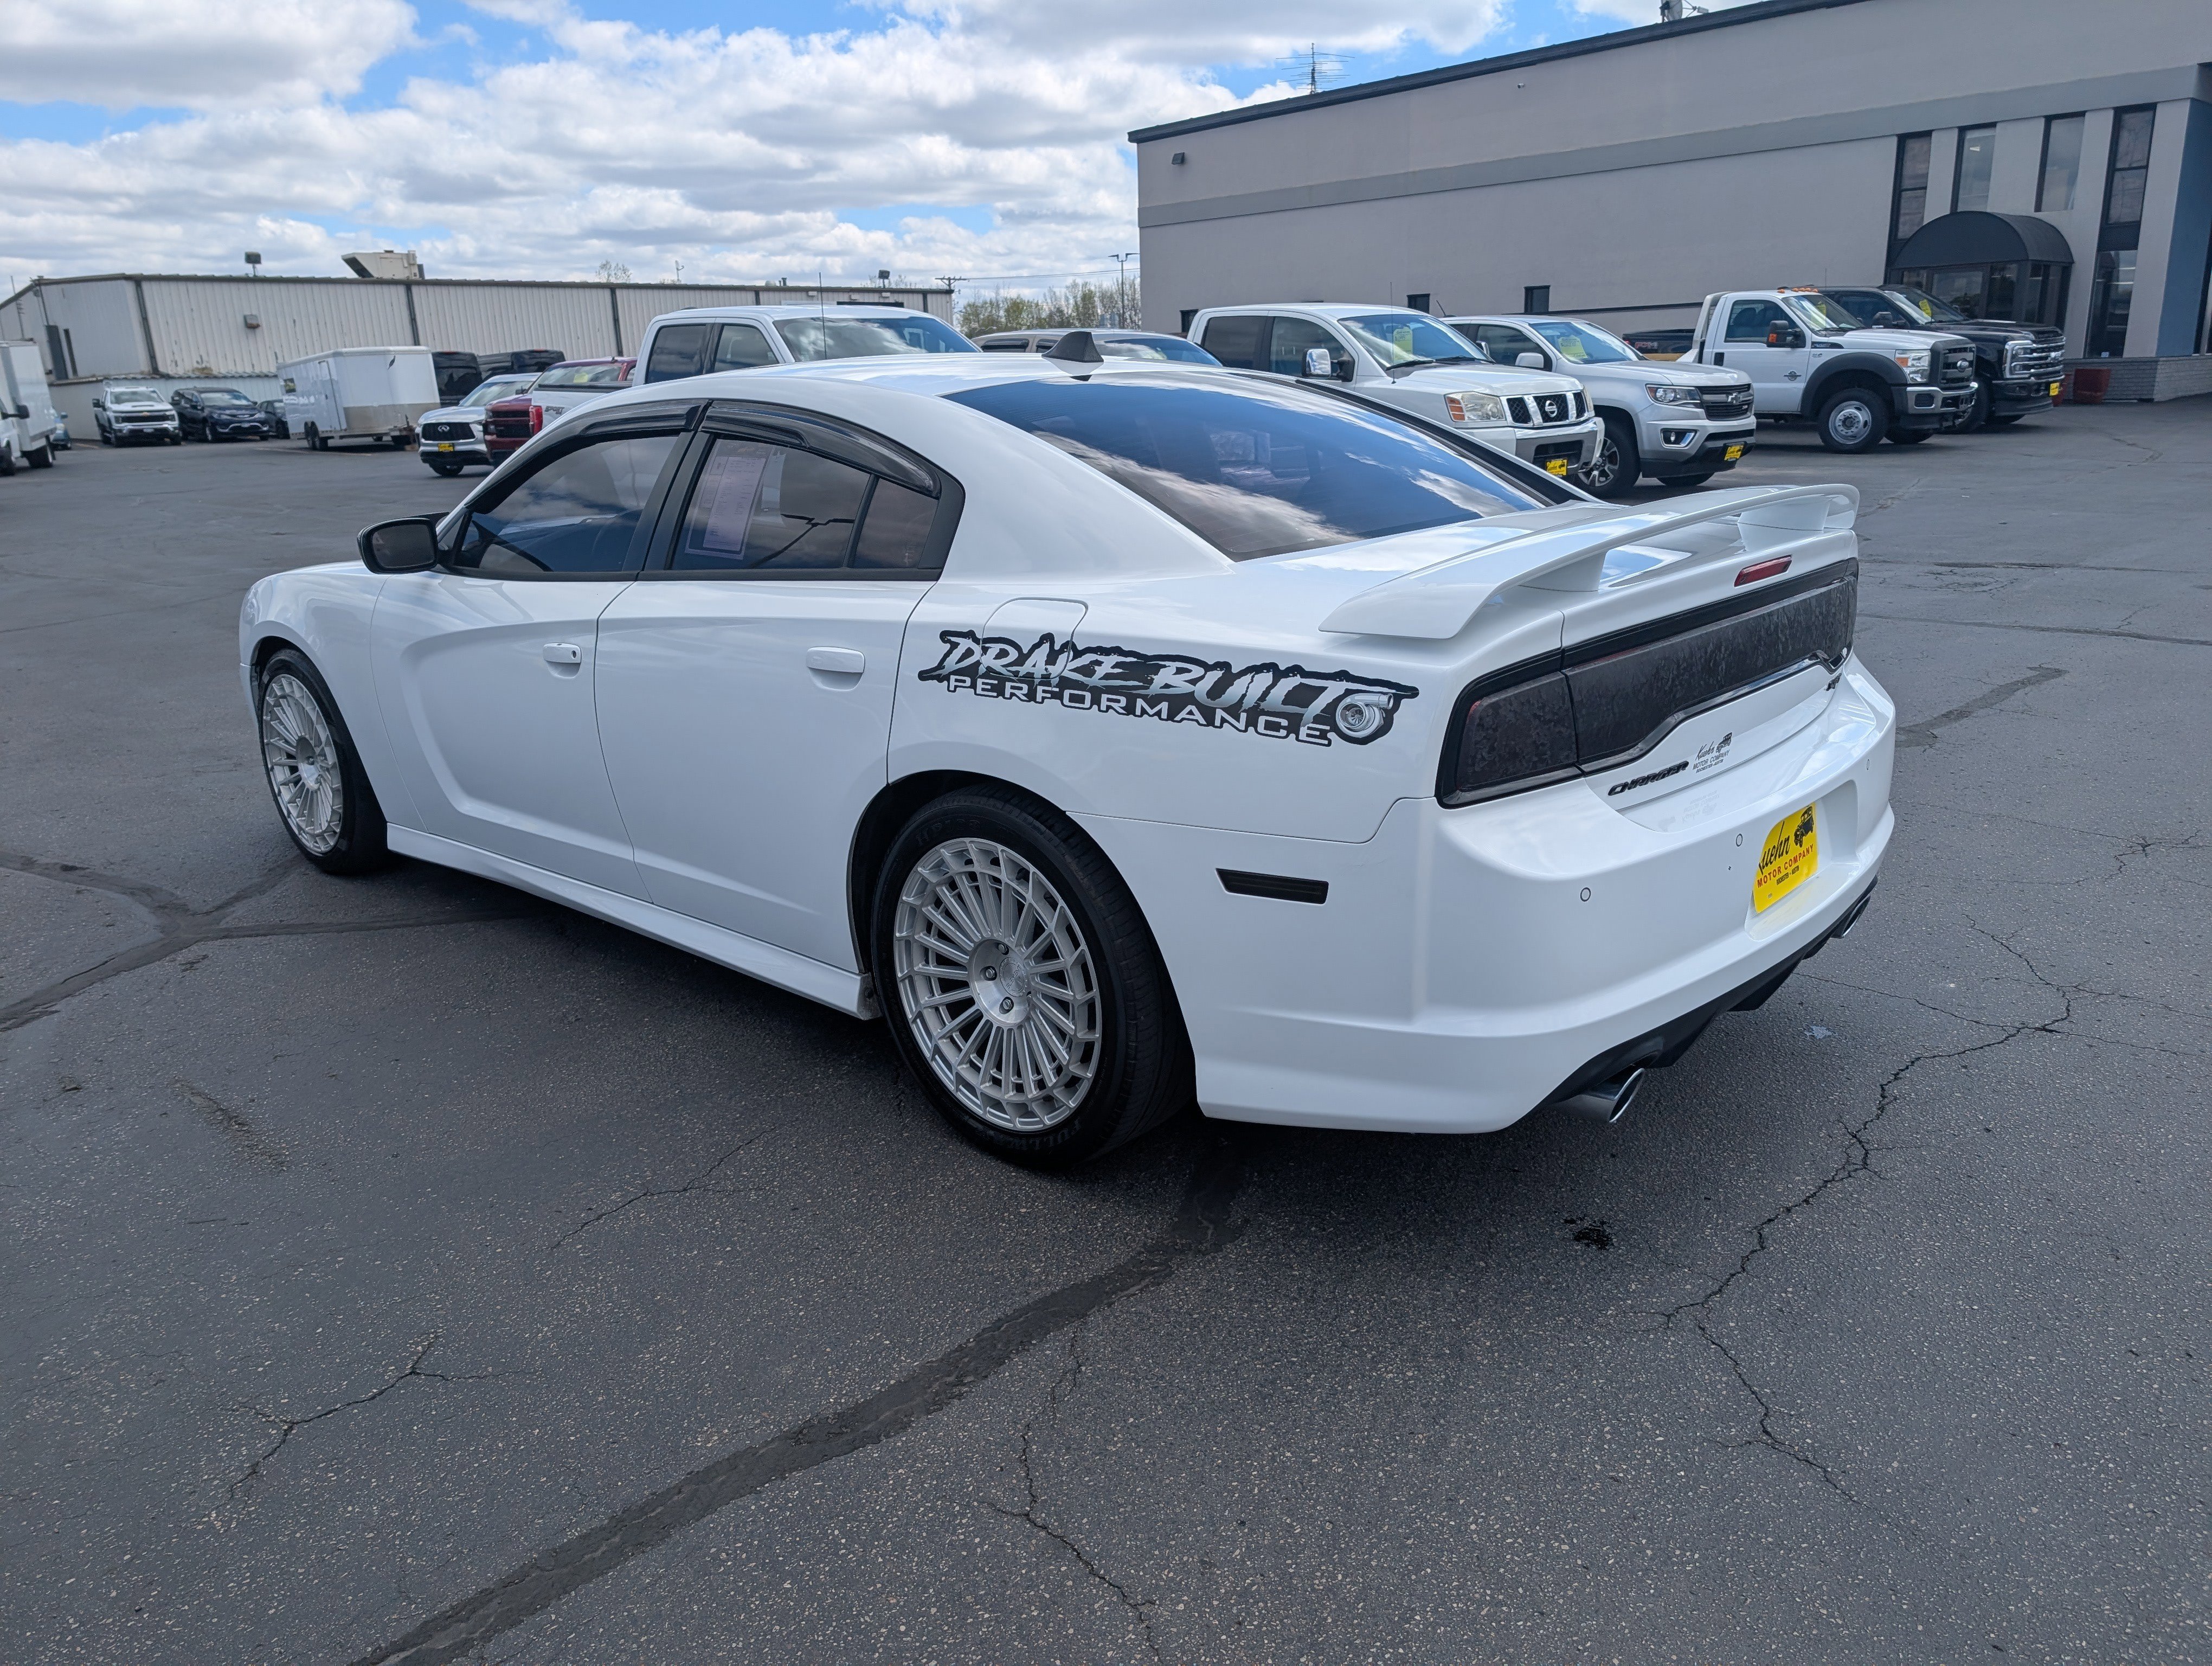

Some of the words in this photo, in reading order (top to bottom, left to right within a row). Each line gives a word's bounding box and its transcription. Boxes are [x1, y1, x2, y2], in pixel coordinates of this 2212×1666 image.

[922, 636, 1153, 690] DRAKE
[1120, 661, 1412, 727] BUILT
[949, 675, 1330, 745] PERFORMANCE
[1693, 759, 1708, 770] MOTOR
[1710, 749, 1730, 763] COMPANY
[1695, 741, 1715, 760] Kuehn
[1607, 760, 1689, 796] CHARGER
[1757, 866, 1782, 888] MOTOR
[1784, 843, 1814, 870] COMPANY
